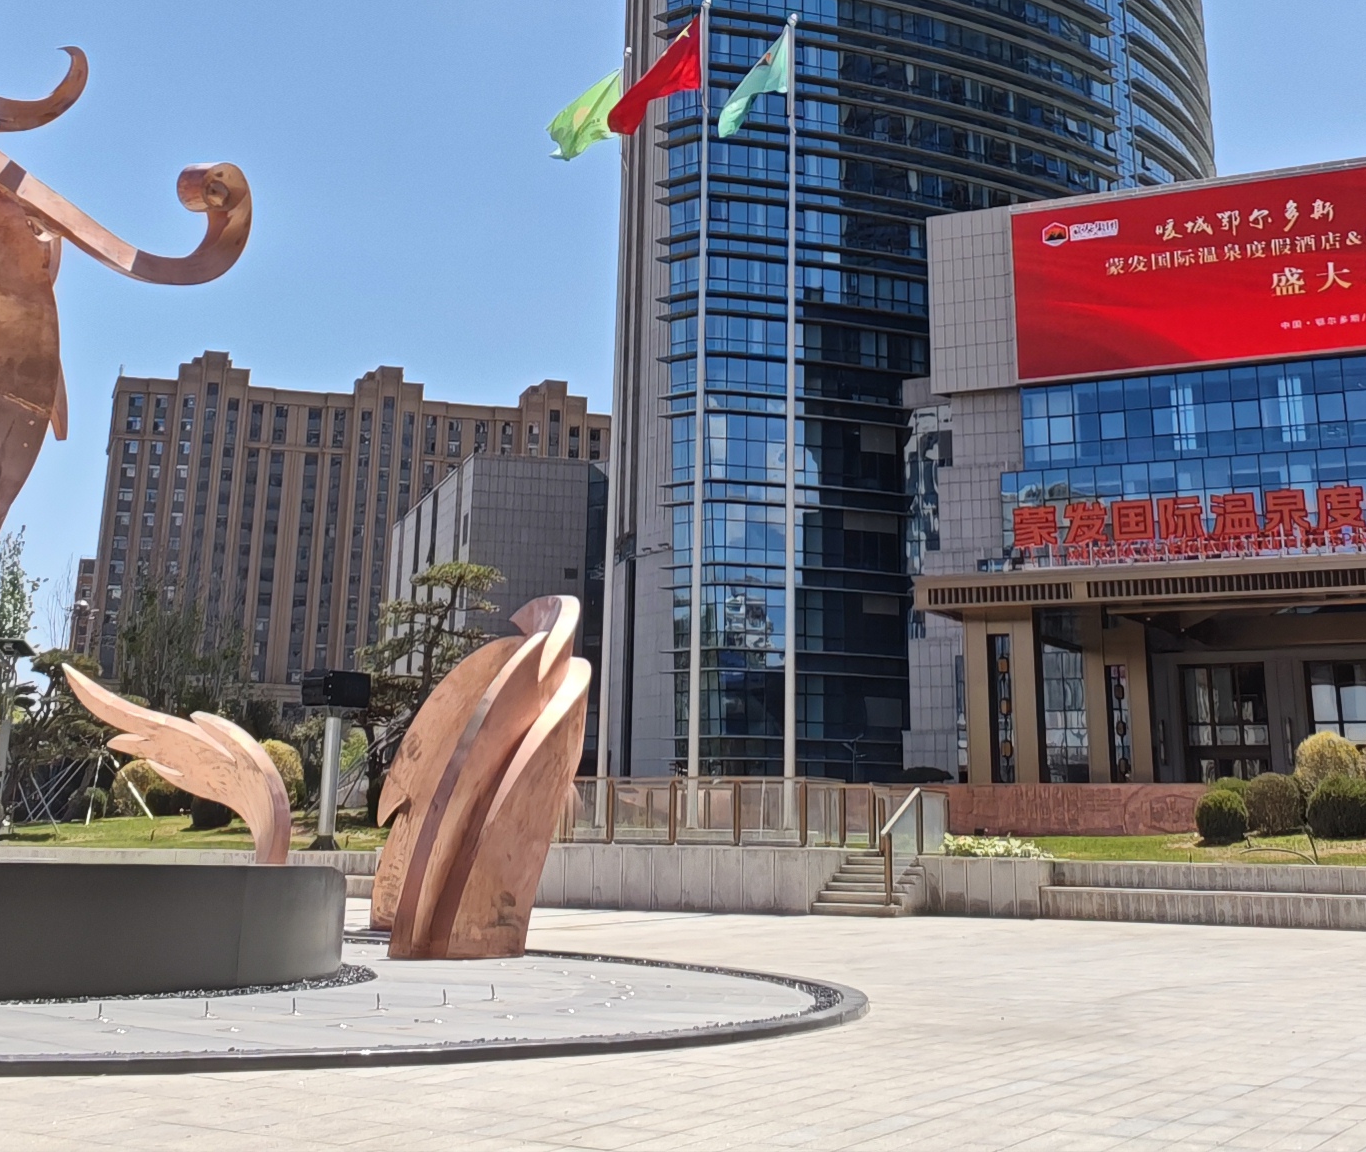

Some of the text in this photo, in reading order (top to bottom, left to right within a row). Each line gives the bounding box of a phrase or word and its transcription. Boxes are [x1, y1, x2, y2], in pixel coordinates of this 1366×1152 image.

[1155, 198, 1335, 242] 暖城鄂尔多斯
